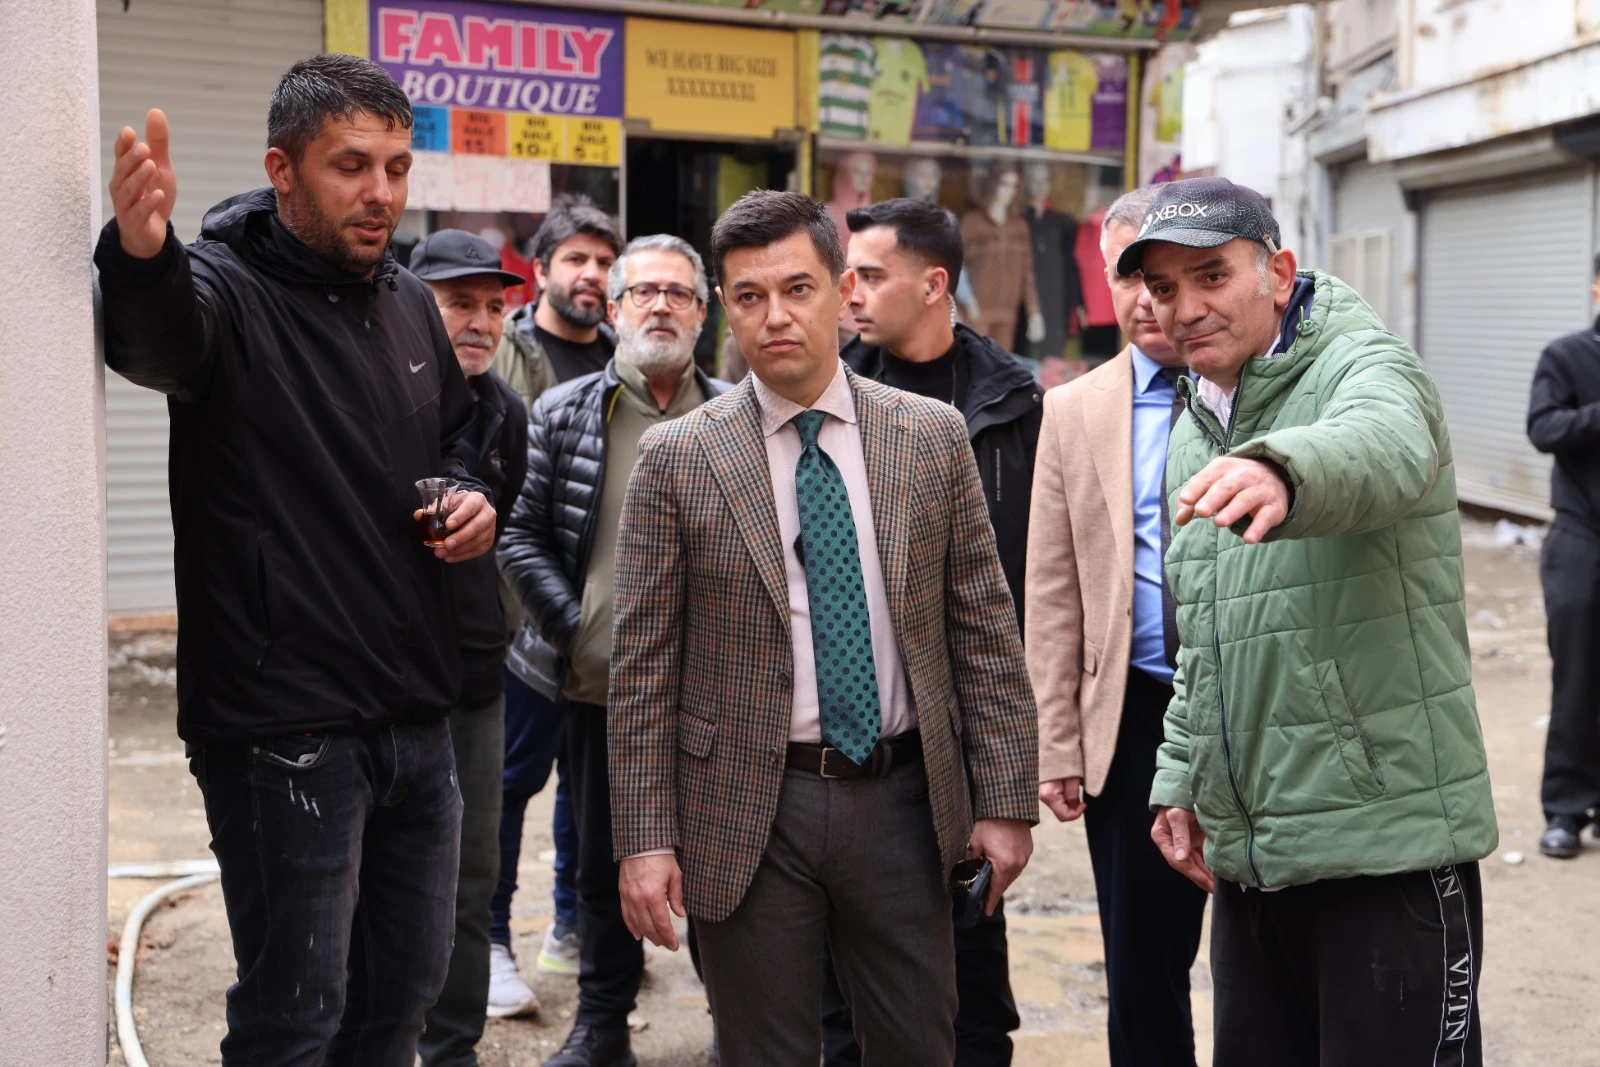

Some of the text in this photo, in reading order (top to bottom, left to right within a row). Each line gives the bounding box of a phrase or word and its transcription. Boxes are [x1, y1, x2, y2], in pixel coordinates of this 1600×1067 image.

[379, 8, 615, 79] FAMILY
[402, 70, 600, 114] BOUTIQUE
[1154, 203, 1208, 224] XBOX
[1445, 953, 1470, 1041] VLTN
